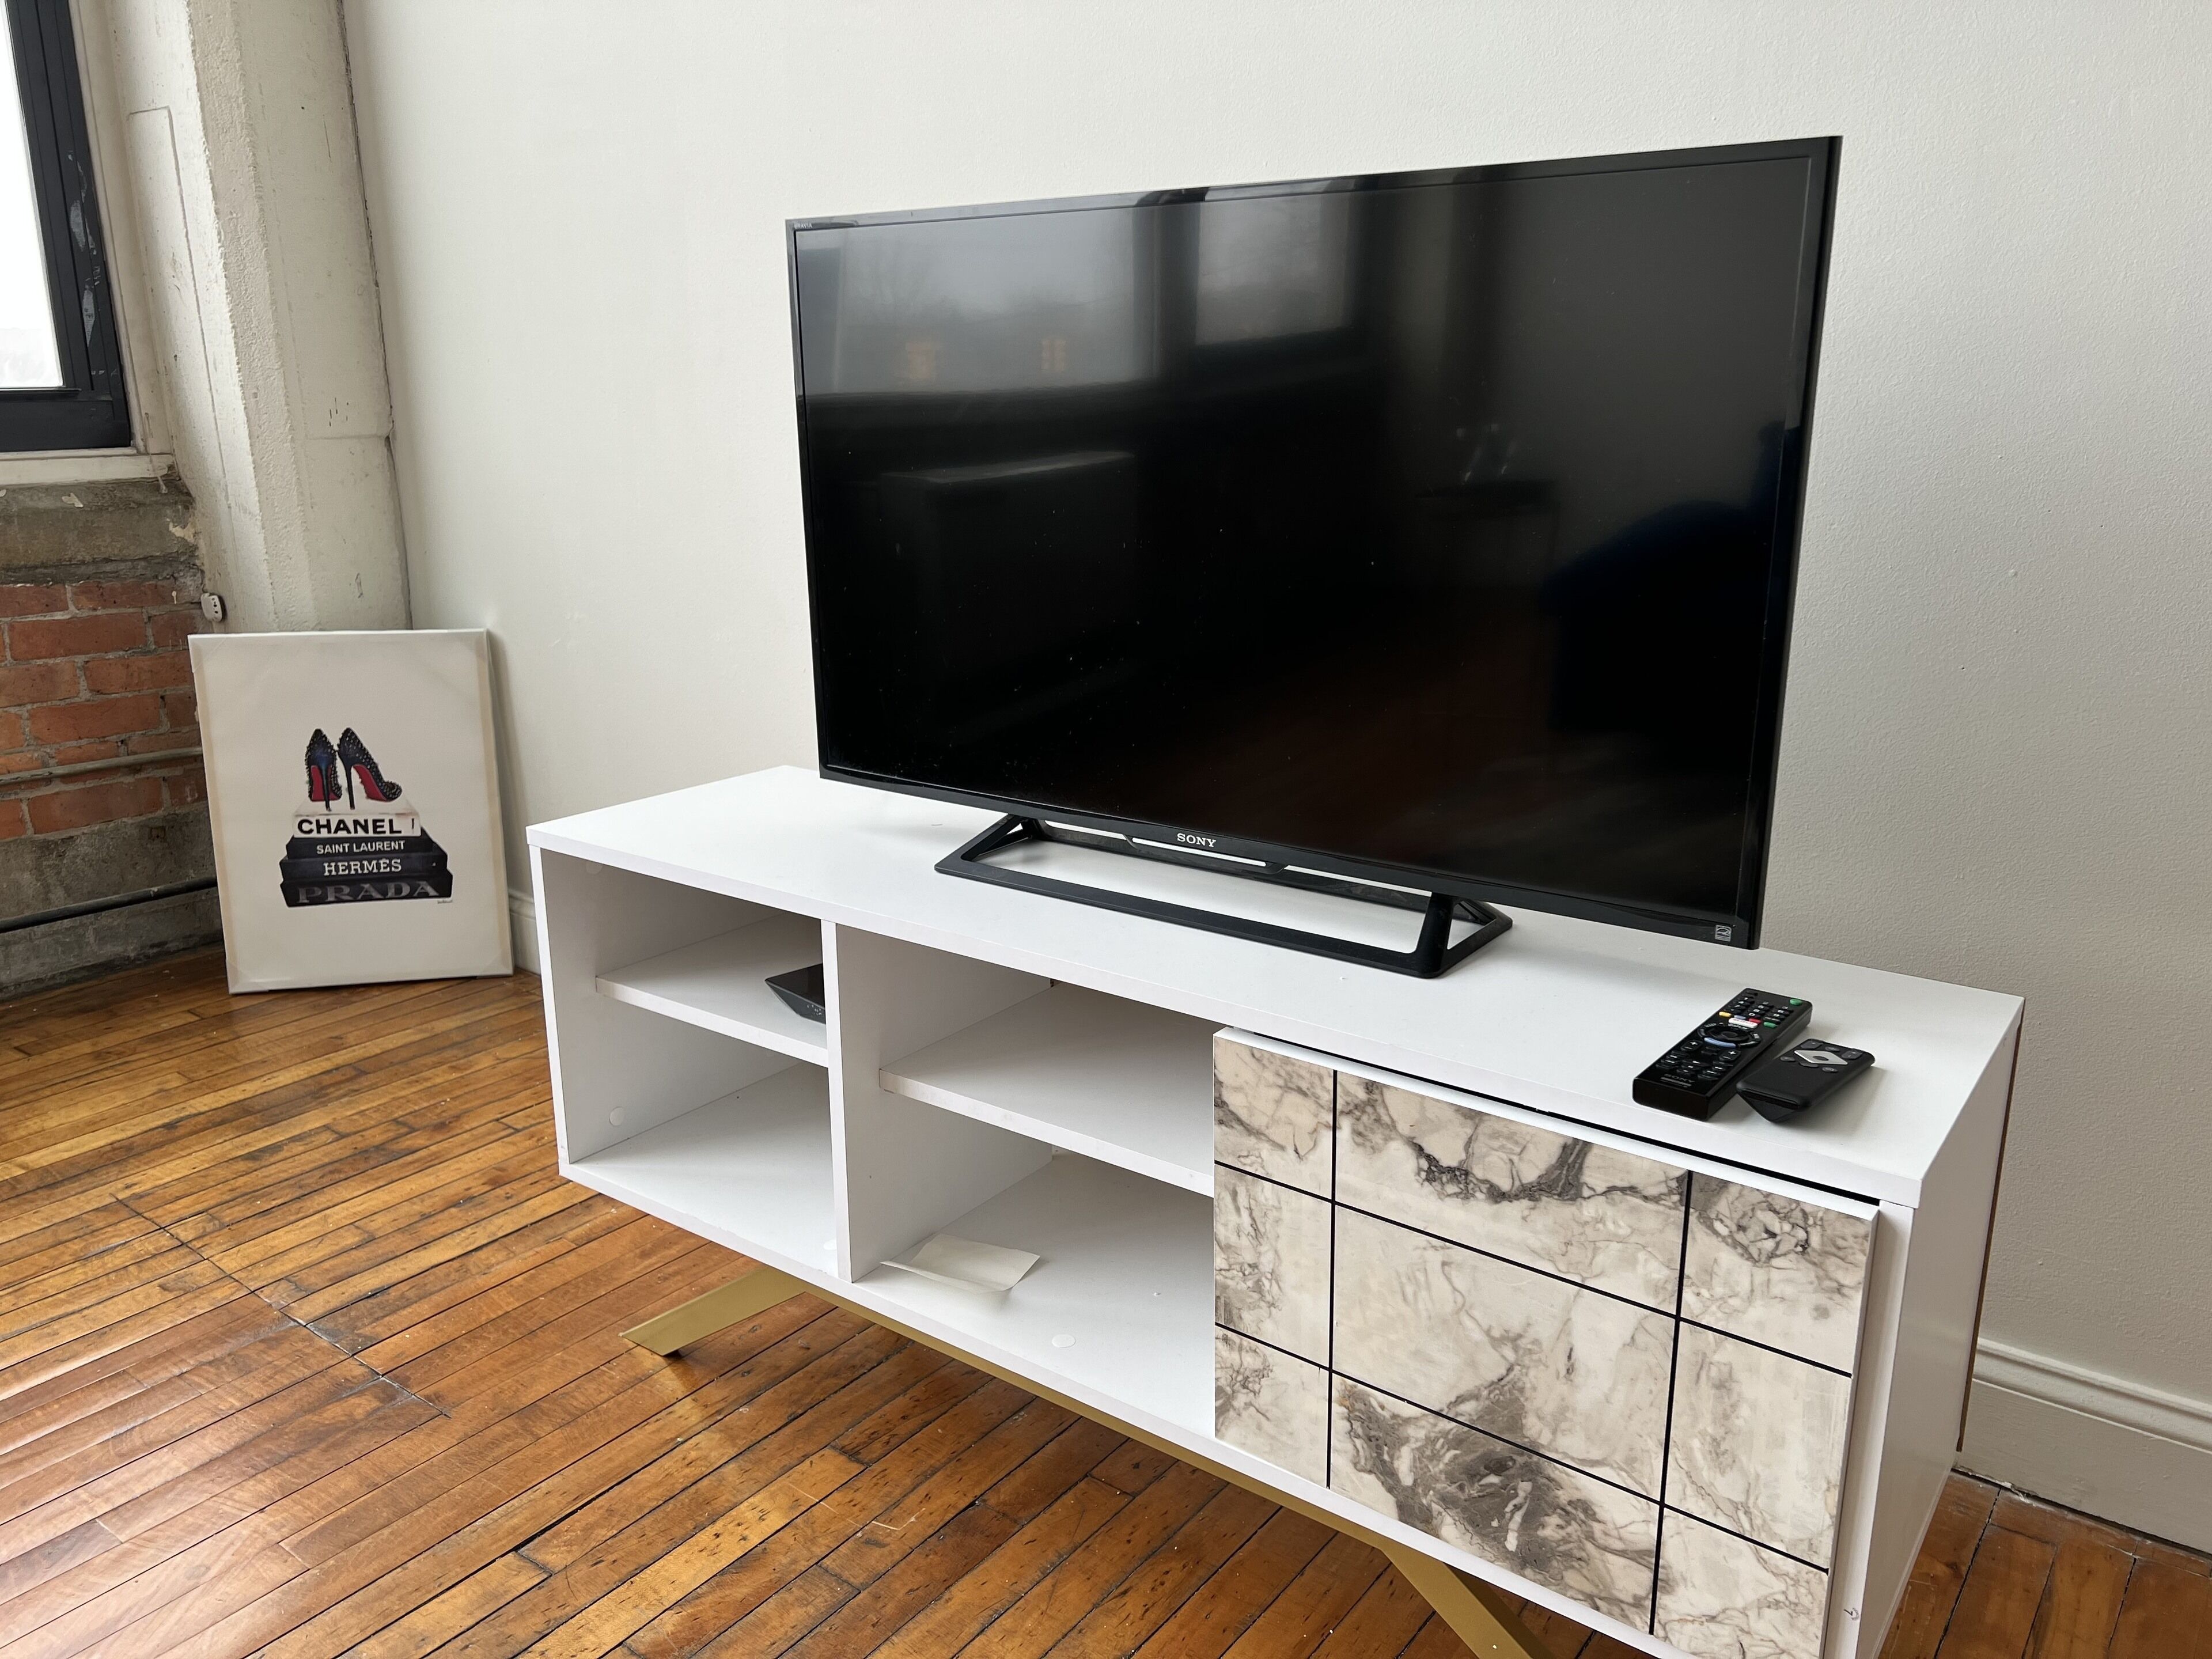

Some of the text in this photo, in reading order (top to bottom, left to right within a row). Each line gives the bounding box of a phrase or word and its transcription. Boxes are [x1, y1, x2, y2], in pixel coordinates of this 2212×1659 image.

[297, 818, 402, 835] CHANEL
[317, 840, 406, 855] SAINT LAURENT
[1177, 833, 1217, 847] SONY
[297, 880, 440, 904] PRADA
